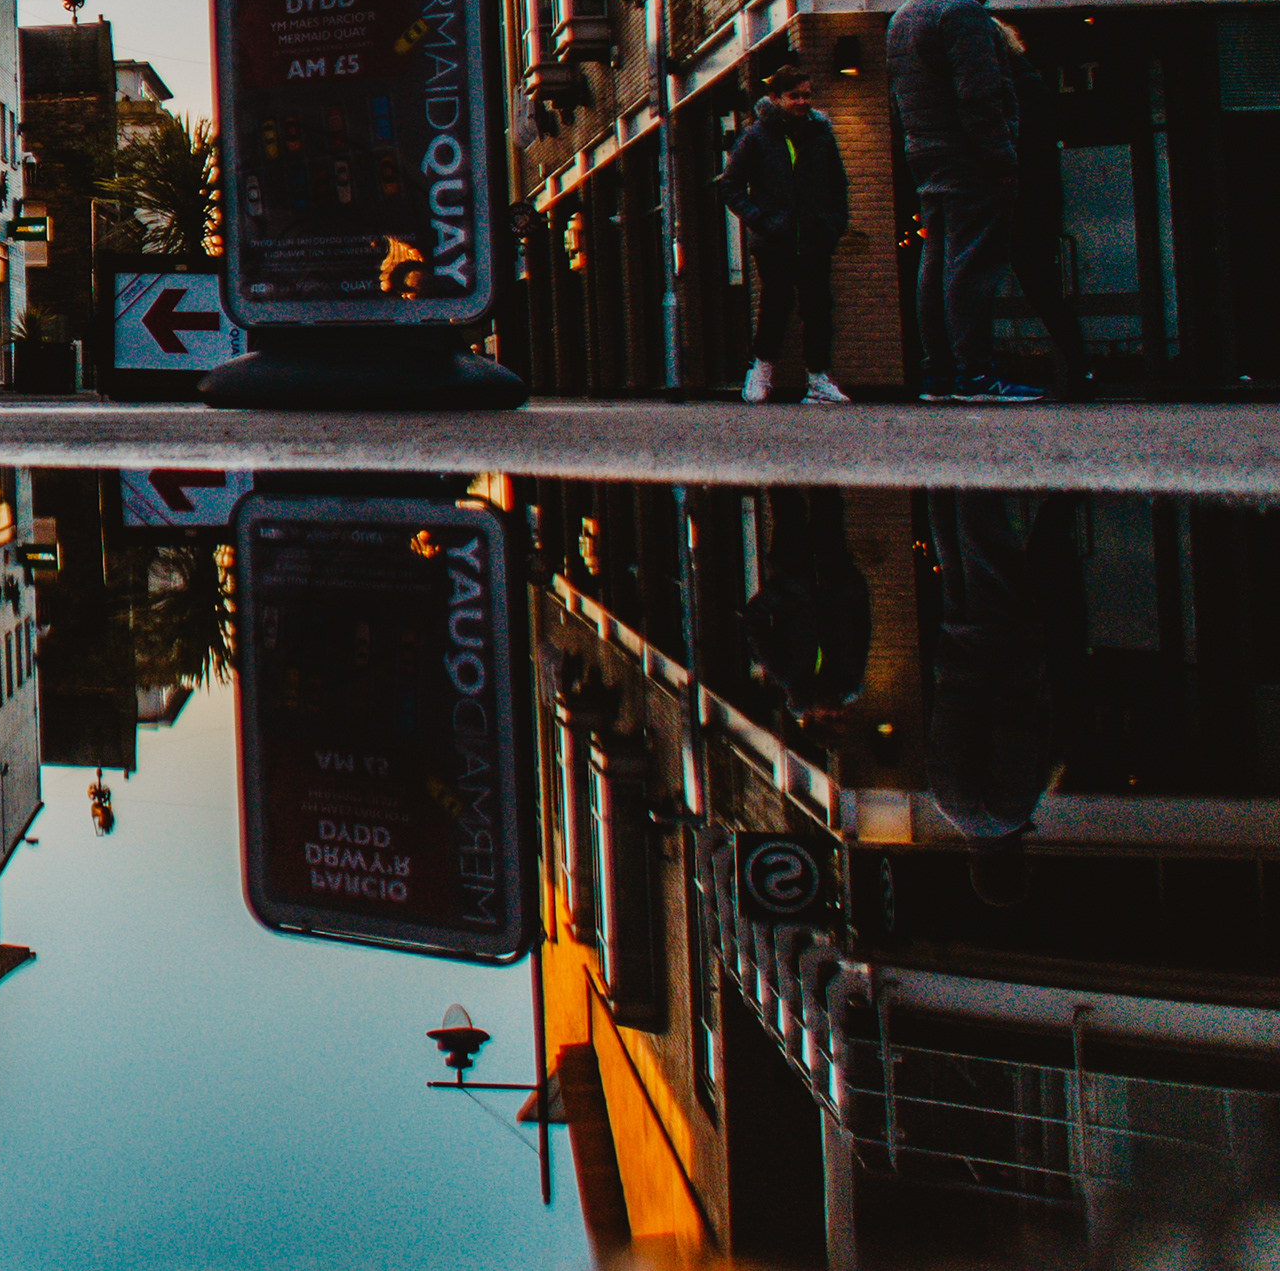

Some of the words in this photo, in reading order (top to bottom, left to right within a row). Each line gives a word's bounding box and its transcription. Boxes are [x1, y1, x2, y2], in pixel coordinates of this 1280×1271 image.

[270, 21, 287, 33] YM
[289, 16, 320, 30] MAES
[322, 11, 377, 26] PARCIO'R
[278, 30, 331, 45] MERMAID
[333, 25, 368, 41] QUAY
[286, 57, 326, 81] AM
[333, 53, 360, 76] £5
[340, 280, 373, 293] QUAY
